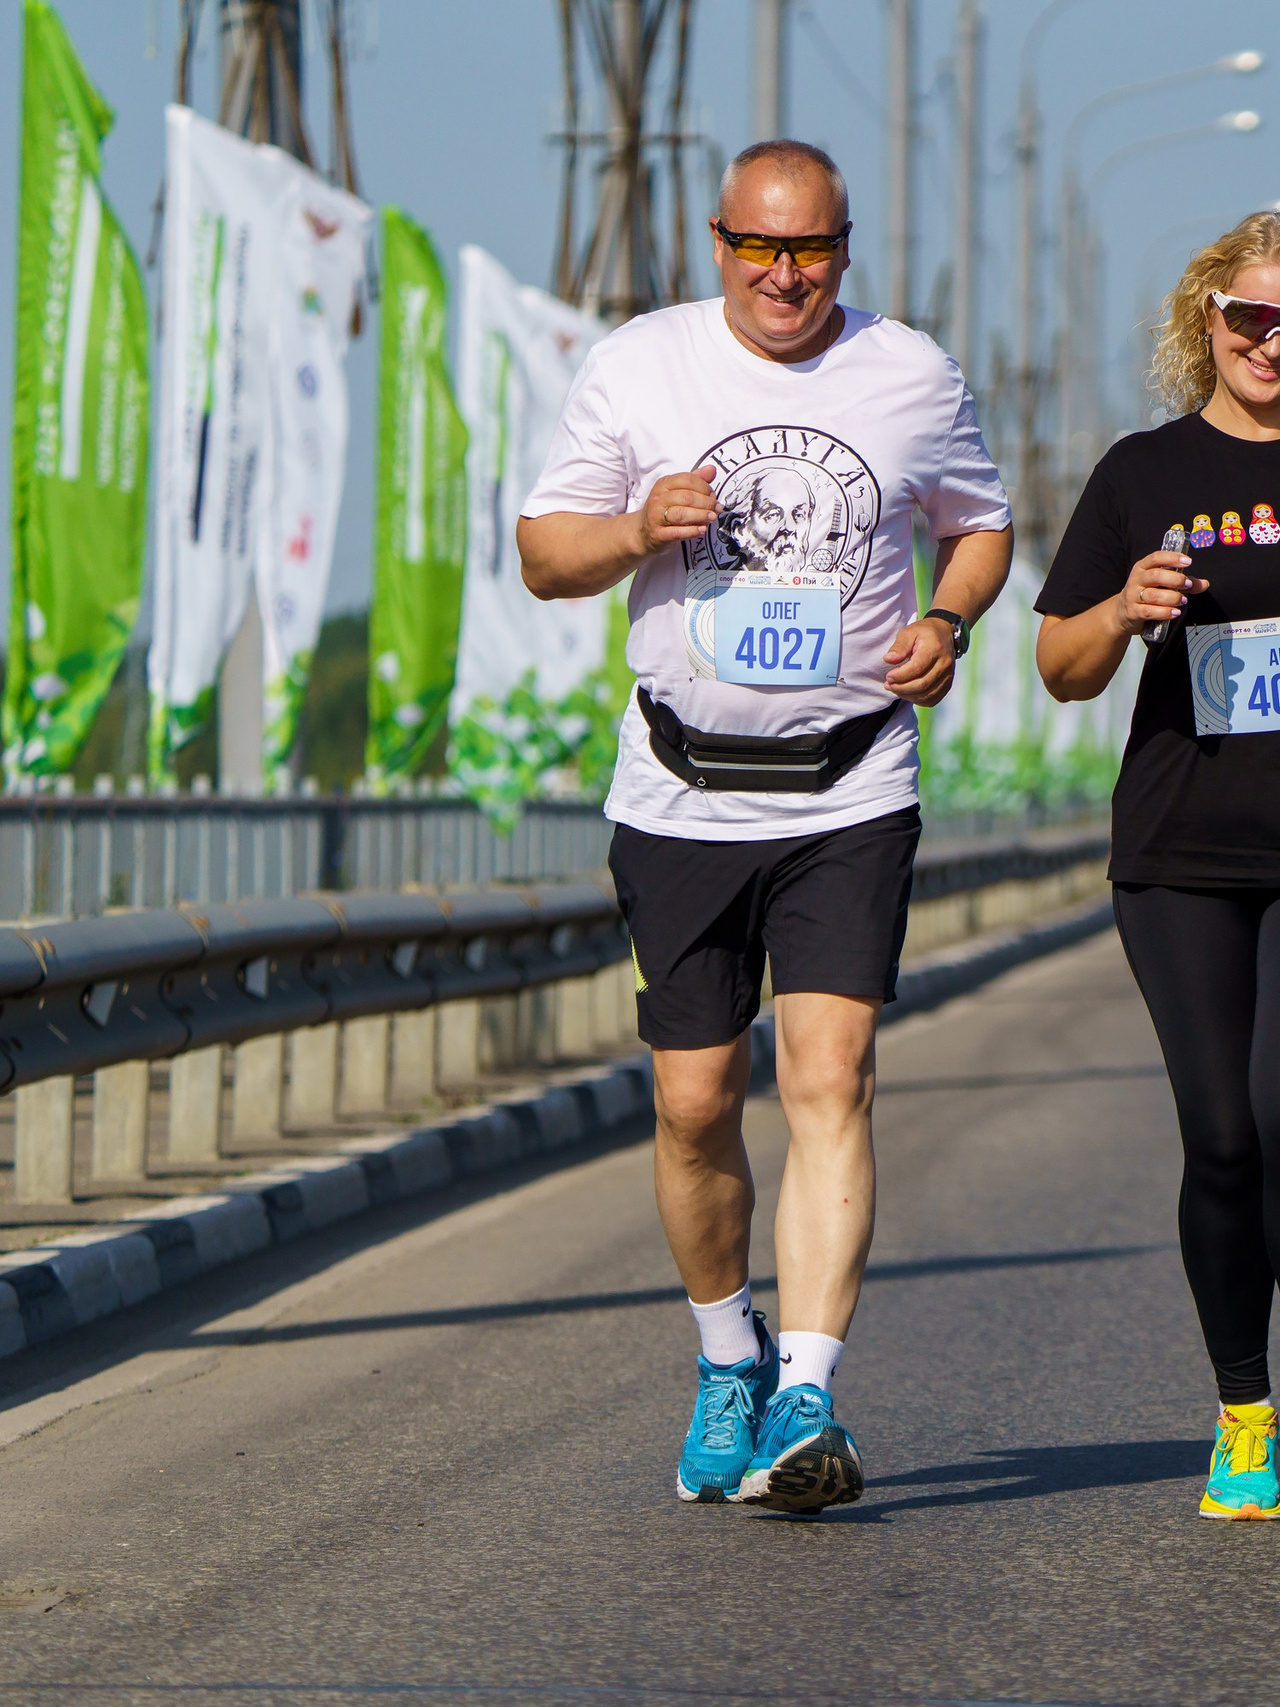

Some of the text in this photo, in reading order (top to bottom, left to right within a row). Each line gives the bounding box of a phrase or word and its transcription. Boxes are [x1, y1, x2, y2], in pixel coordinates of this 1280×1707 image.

[710, 430, 867, 488] КАЛУГА
[802, 576, 817, 585] Пэй
[762, 602, 801, 620] ОЛЕГ
[735, 626, 826, 671] 4027
